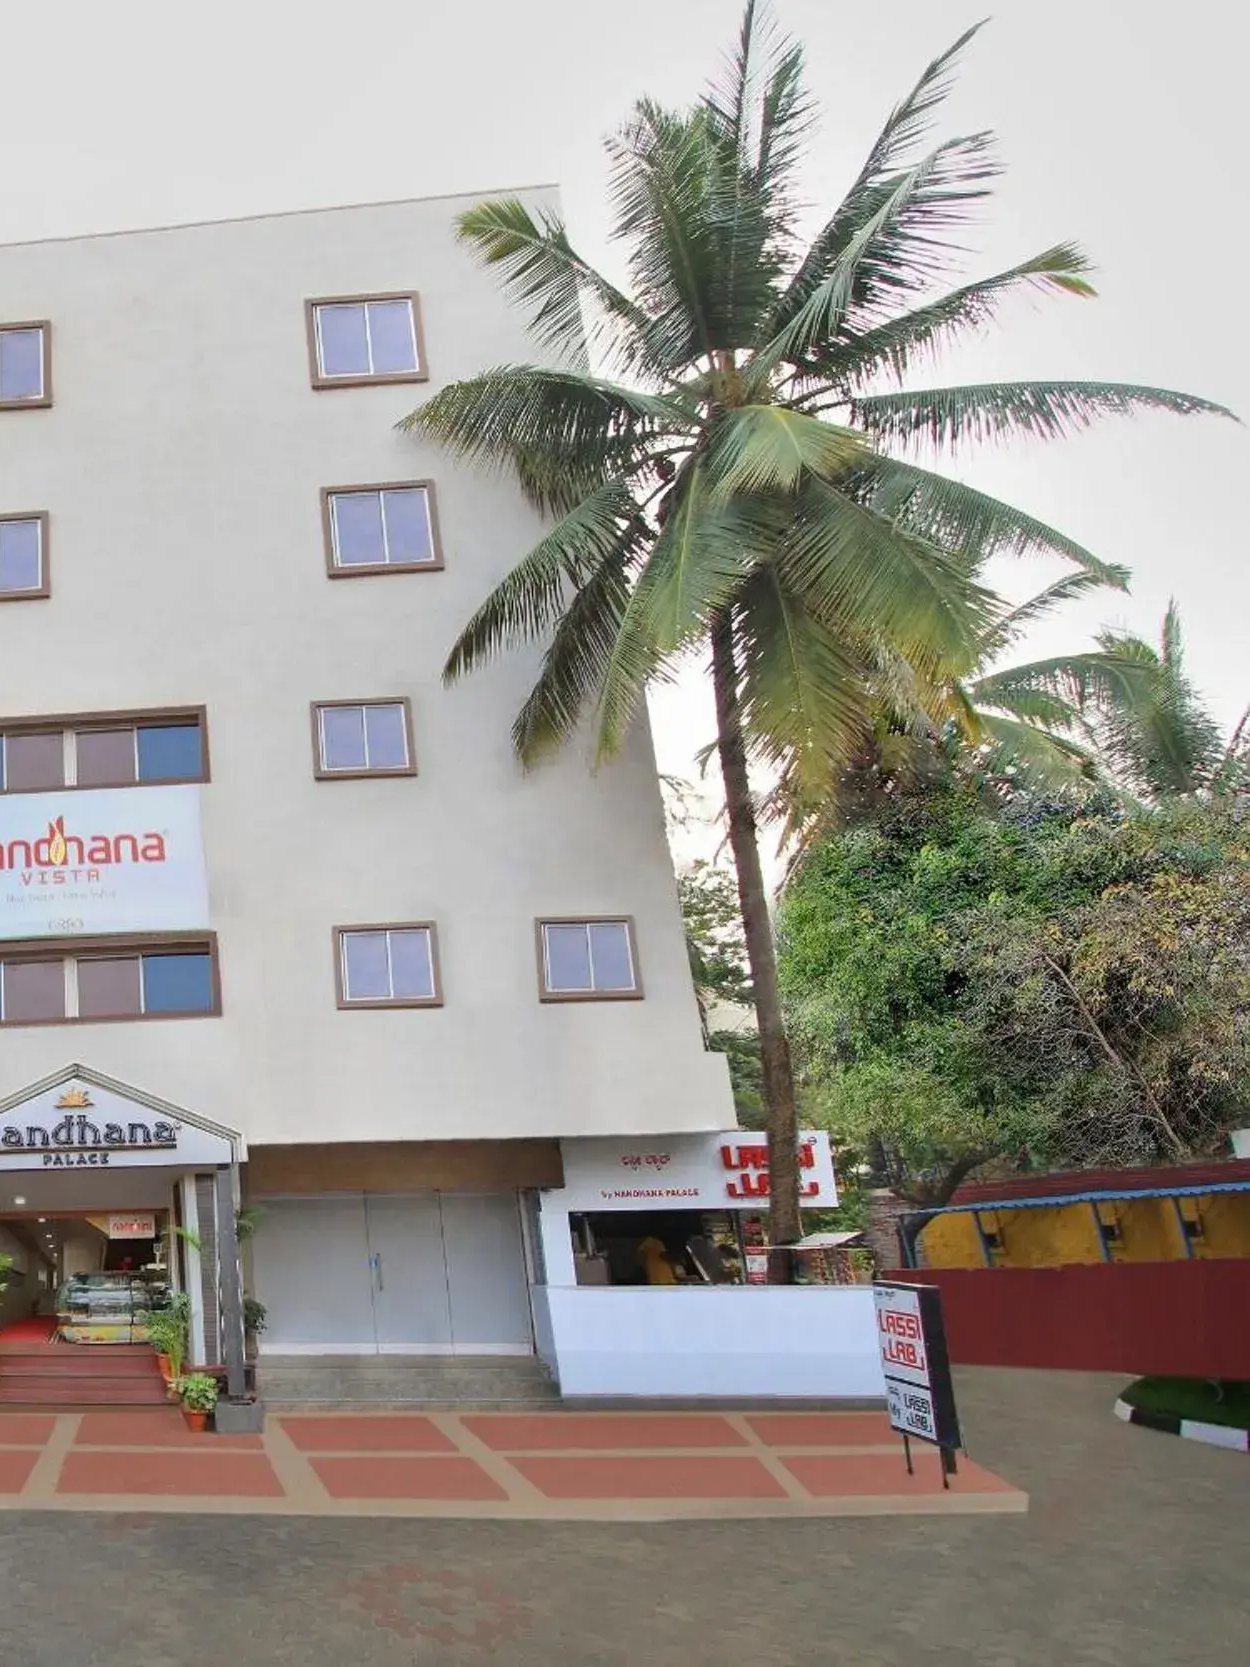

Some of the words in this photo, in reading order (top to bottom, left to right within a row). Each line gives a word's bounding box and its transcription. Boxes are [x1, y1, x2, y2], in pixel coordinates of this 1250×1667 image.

[20, 870, 100, 886] VISTA
[43, 1152, 110, 1166] PALACE
[878, 1308, 922, 1340] LASSI
[888, 1338, 918, 1364] LAB
